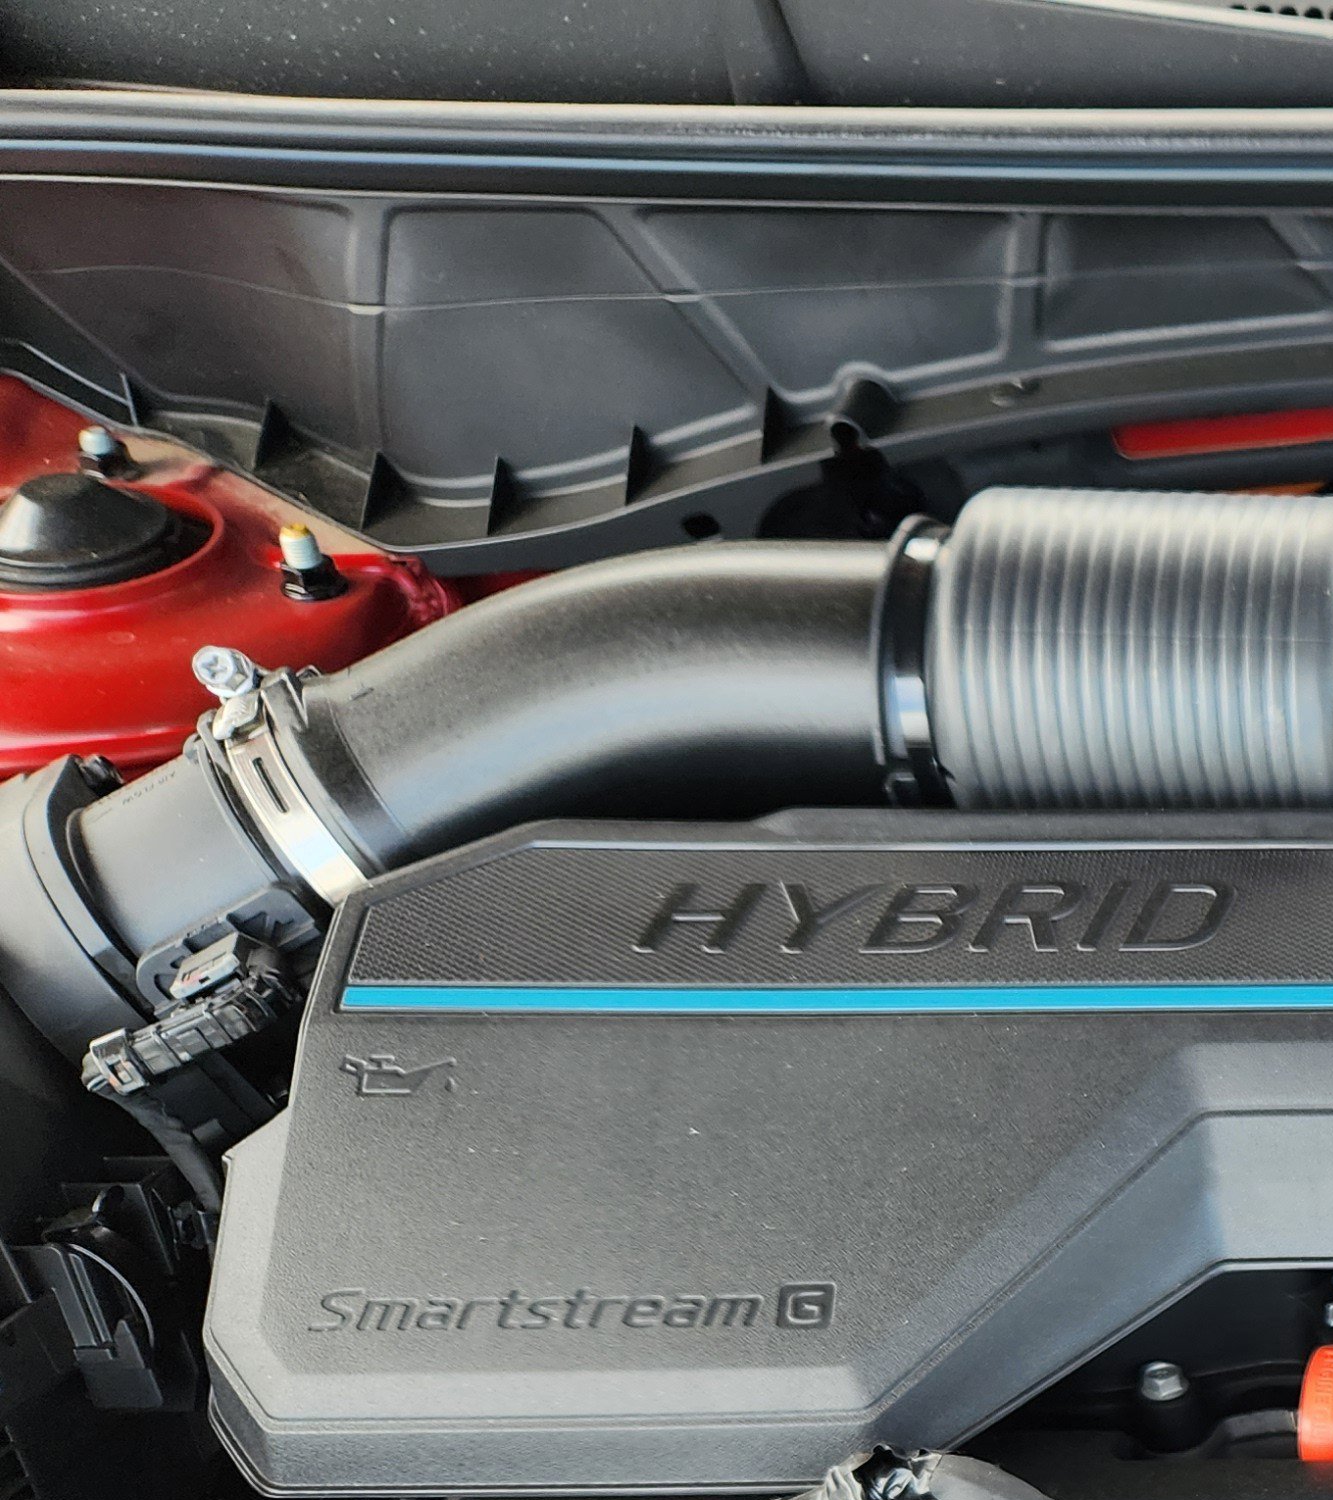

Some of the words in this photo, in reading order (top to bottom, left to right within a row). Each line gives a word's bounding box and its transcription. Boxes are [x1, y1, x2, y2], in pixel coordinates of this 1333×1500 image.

[630, 880, 1237, 955] HYBRID
[308, 1286, 766, 1333] Smartstream
[781, 1286, 832, 1327] G
